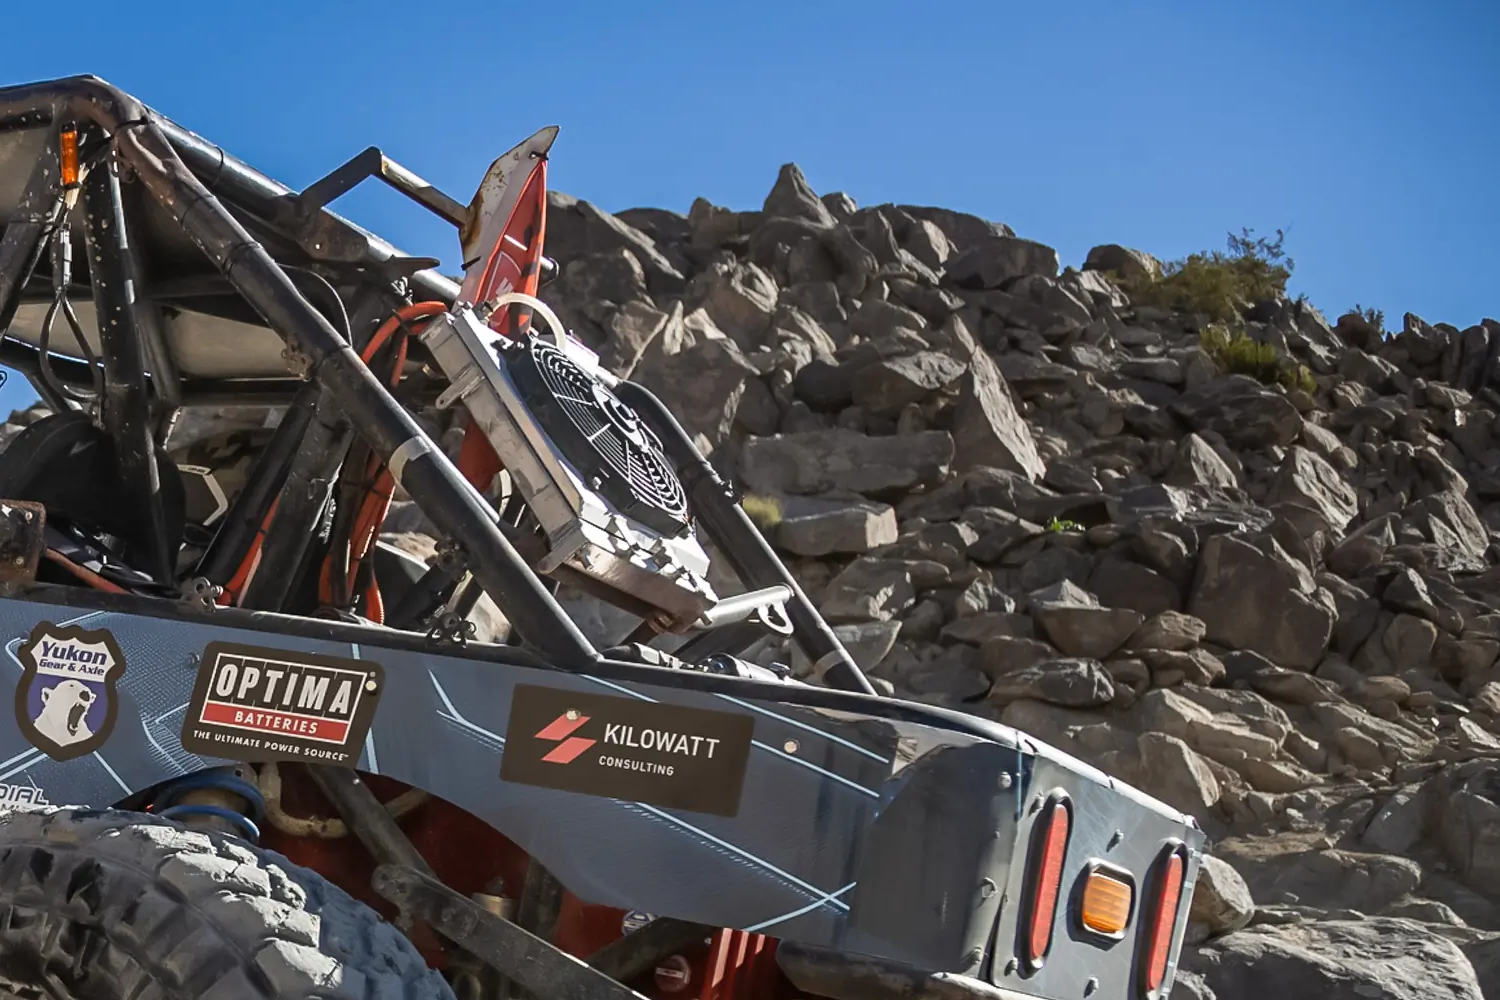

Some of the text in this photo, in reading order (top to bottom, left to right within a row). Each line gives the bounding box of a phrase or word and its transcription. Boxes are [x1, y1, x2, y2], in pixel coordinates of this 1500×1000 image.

[42, 640, 108, 665] Yukon
[39, 658, 105, 676] Gear & Axle
[215, 663, 353, 715] OPTIMA
[234, 711, 319, 735] BATTERIES
[193, 729, 211, 740] THE
[214, 733, 261, 748] ULTIMATE
[264, 740, 300, 755] POWER
[603, 723, 720, 759] KILOWATT
[598, 755, 675, 777] CONSULTING
